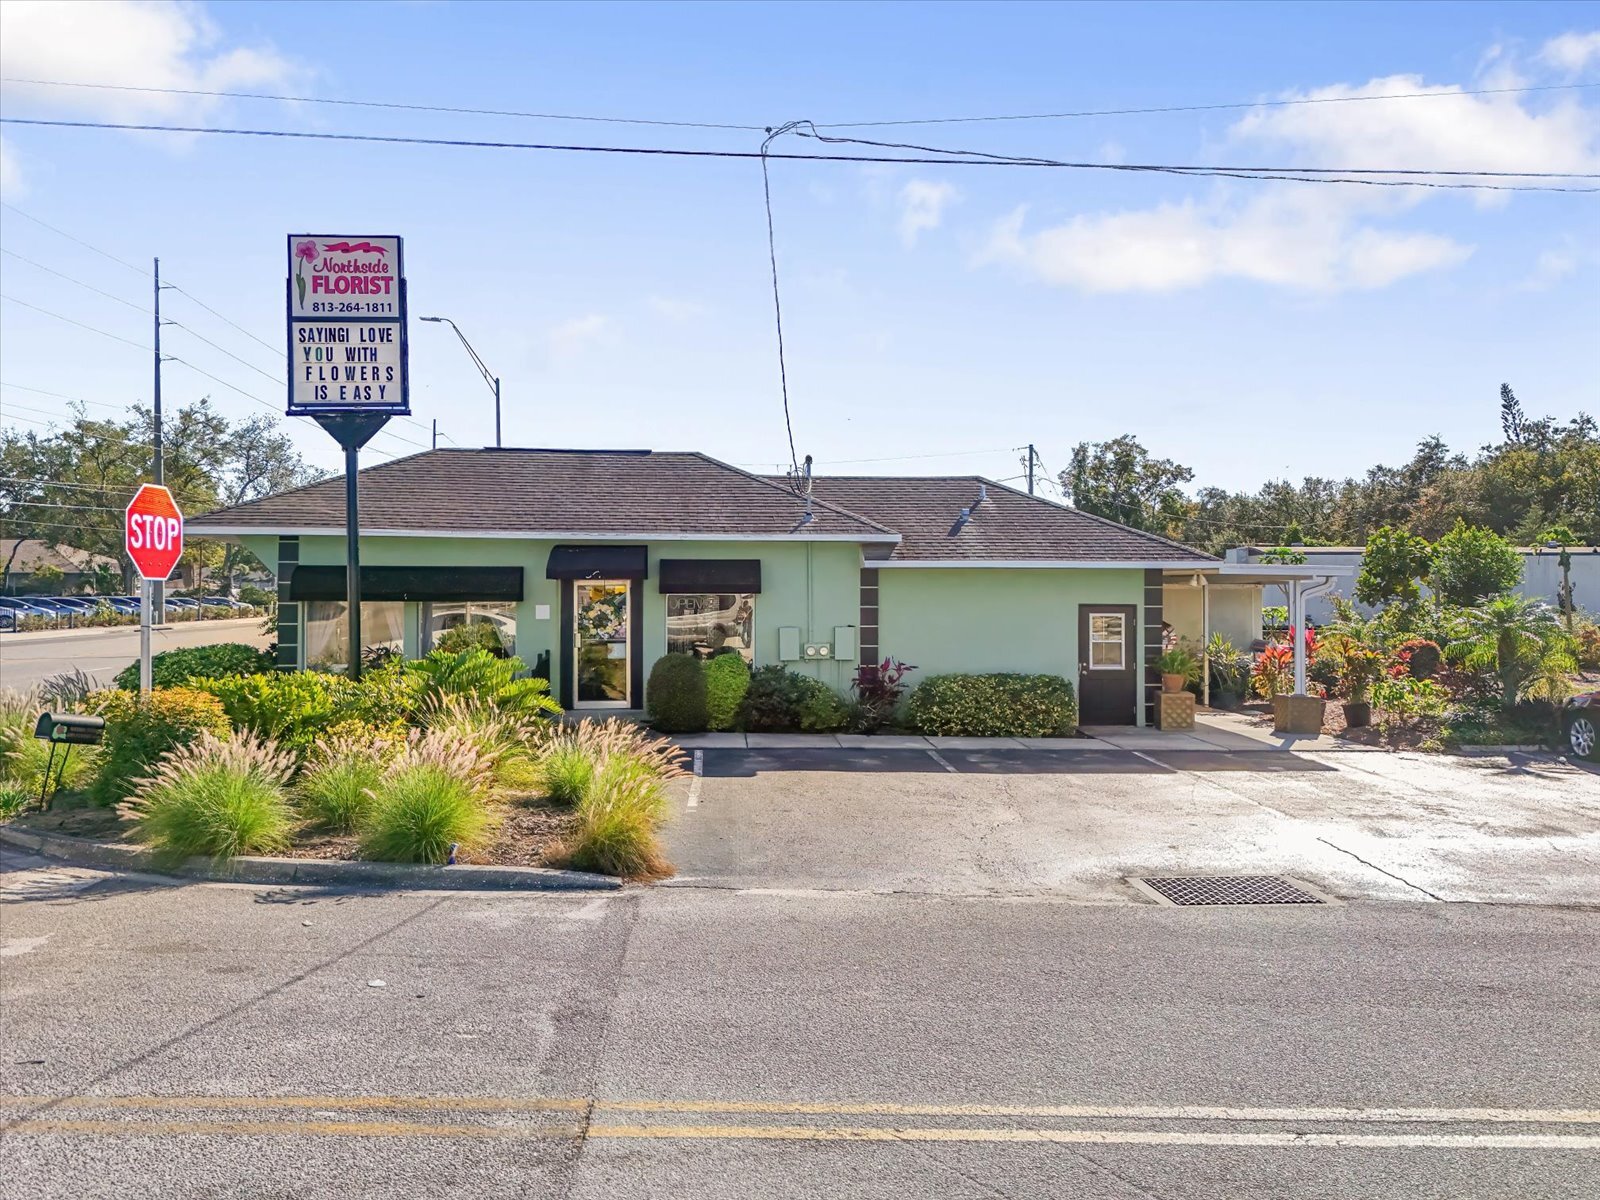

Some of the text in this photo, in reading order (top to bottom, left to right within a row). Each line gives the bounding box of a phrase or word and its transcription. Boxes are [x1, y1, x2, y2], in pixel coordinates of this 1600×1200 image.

[313, 257, 389, 273] Northside
[312, 275, 394, 294] FLORIST
[312, 302, 392, 313] 813-264-1811
[359, 327, 393, 343] LOVE
[303, 346, 378, 362] YOU WITH
[305, 366, 394, 381] FLOWERS
[314, 385, 387, 400] IS EASY
[130, 513, 179, 551] STOP
